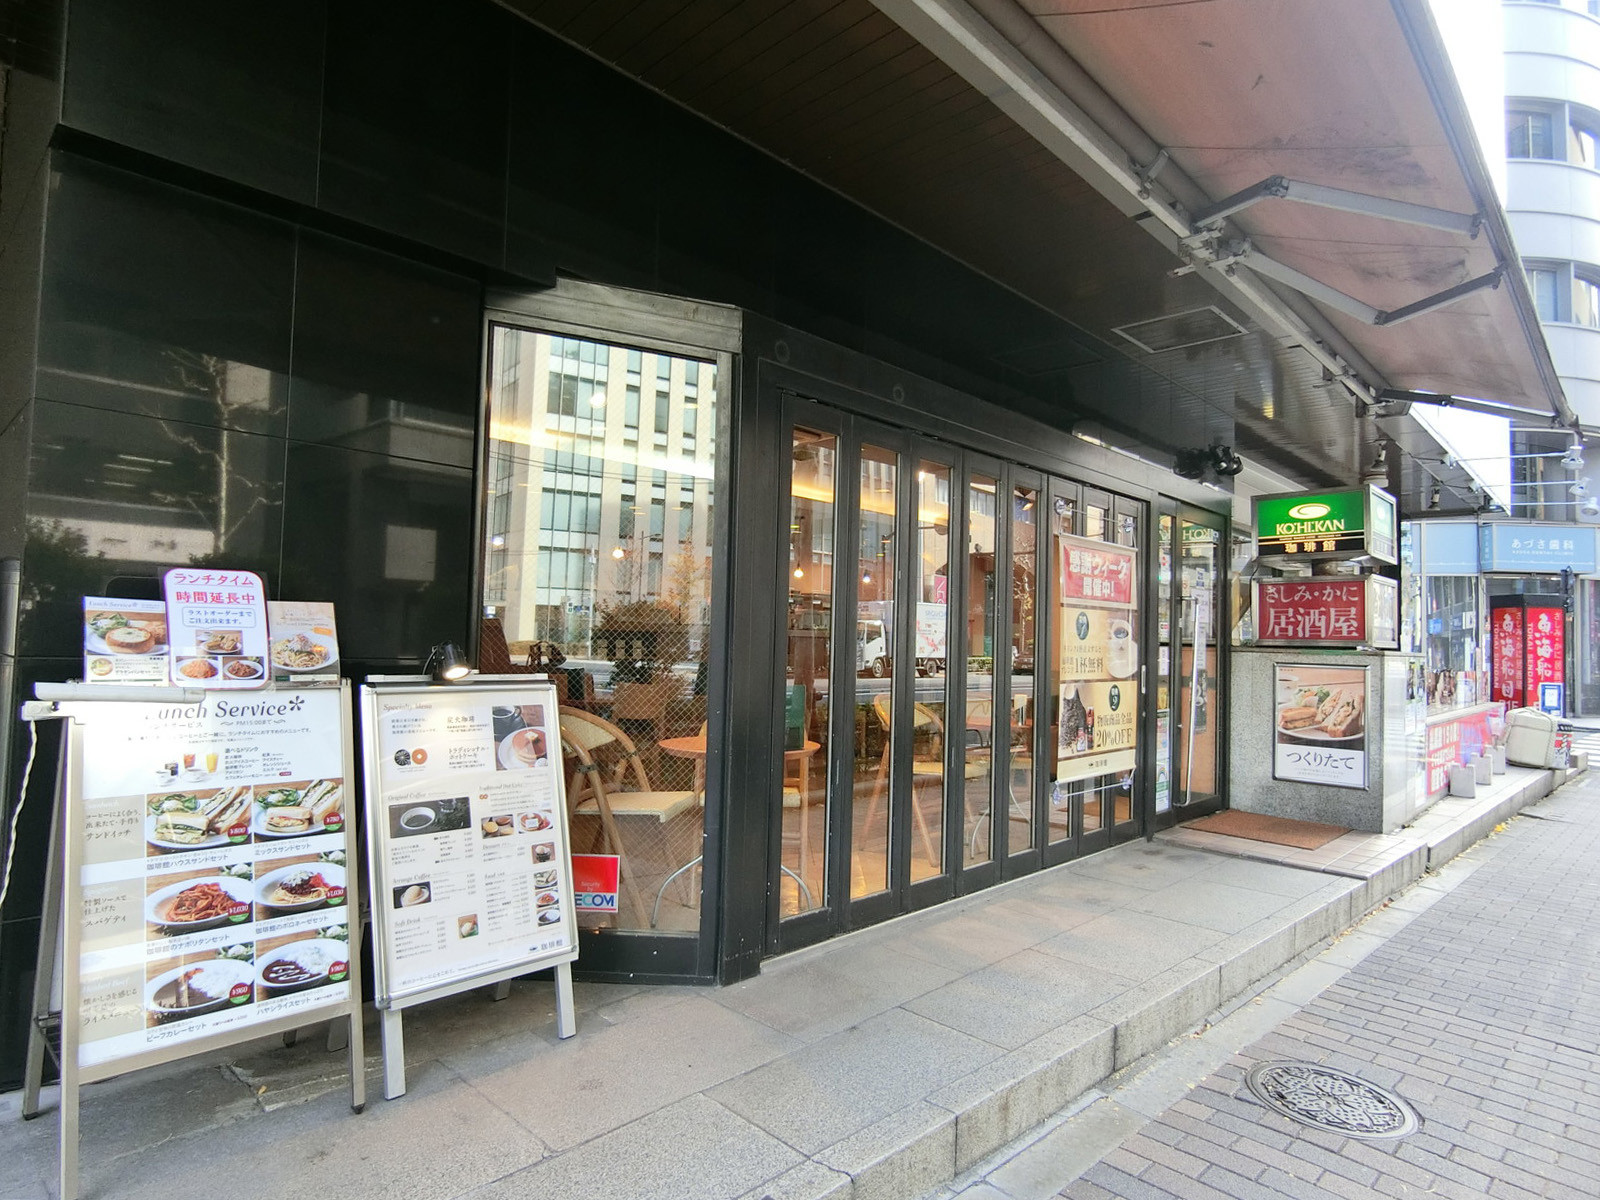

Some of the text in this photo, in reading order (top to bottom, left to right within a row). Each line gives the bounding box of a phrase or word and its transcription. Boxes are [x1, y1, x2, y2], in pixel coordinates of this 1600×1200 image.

[1285, 540, 1336, 553] 珈琲館
[1512, 539, 1574, 550] あづさ歯科
[174, 573, 254, 586] ランチタイム
[175, 591, 256, 605] 時間延長中
[188, 610, 252, 618] ラストオーダーまで
[188, 618, 243, 626] ご注文出来ます。
[1266, 606, 1359, 639] 居酒屋
[145, 700, 287, 721] unch Service
[1096, 728, 1133, 748] 20%OFF
[1286, 751, 1355, 770] つくりたて
[86, 830, 132, 841] サンドイッチ
[255, 843, 312, 856] ミックスサンドセット
[256, 998, 311, 1015] ハヤシライスセット
[146, 1023, 207, 1042] ビーフカレーセット
